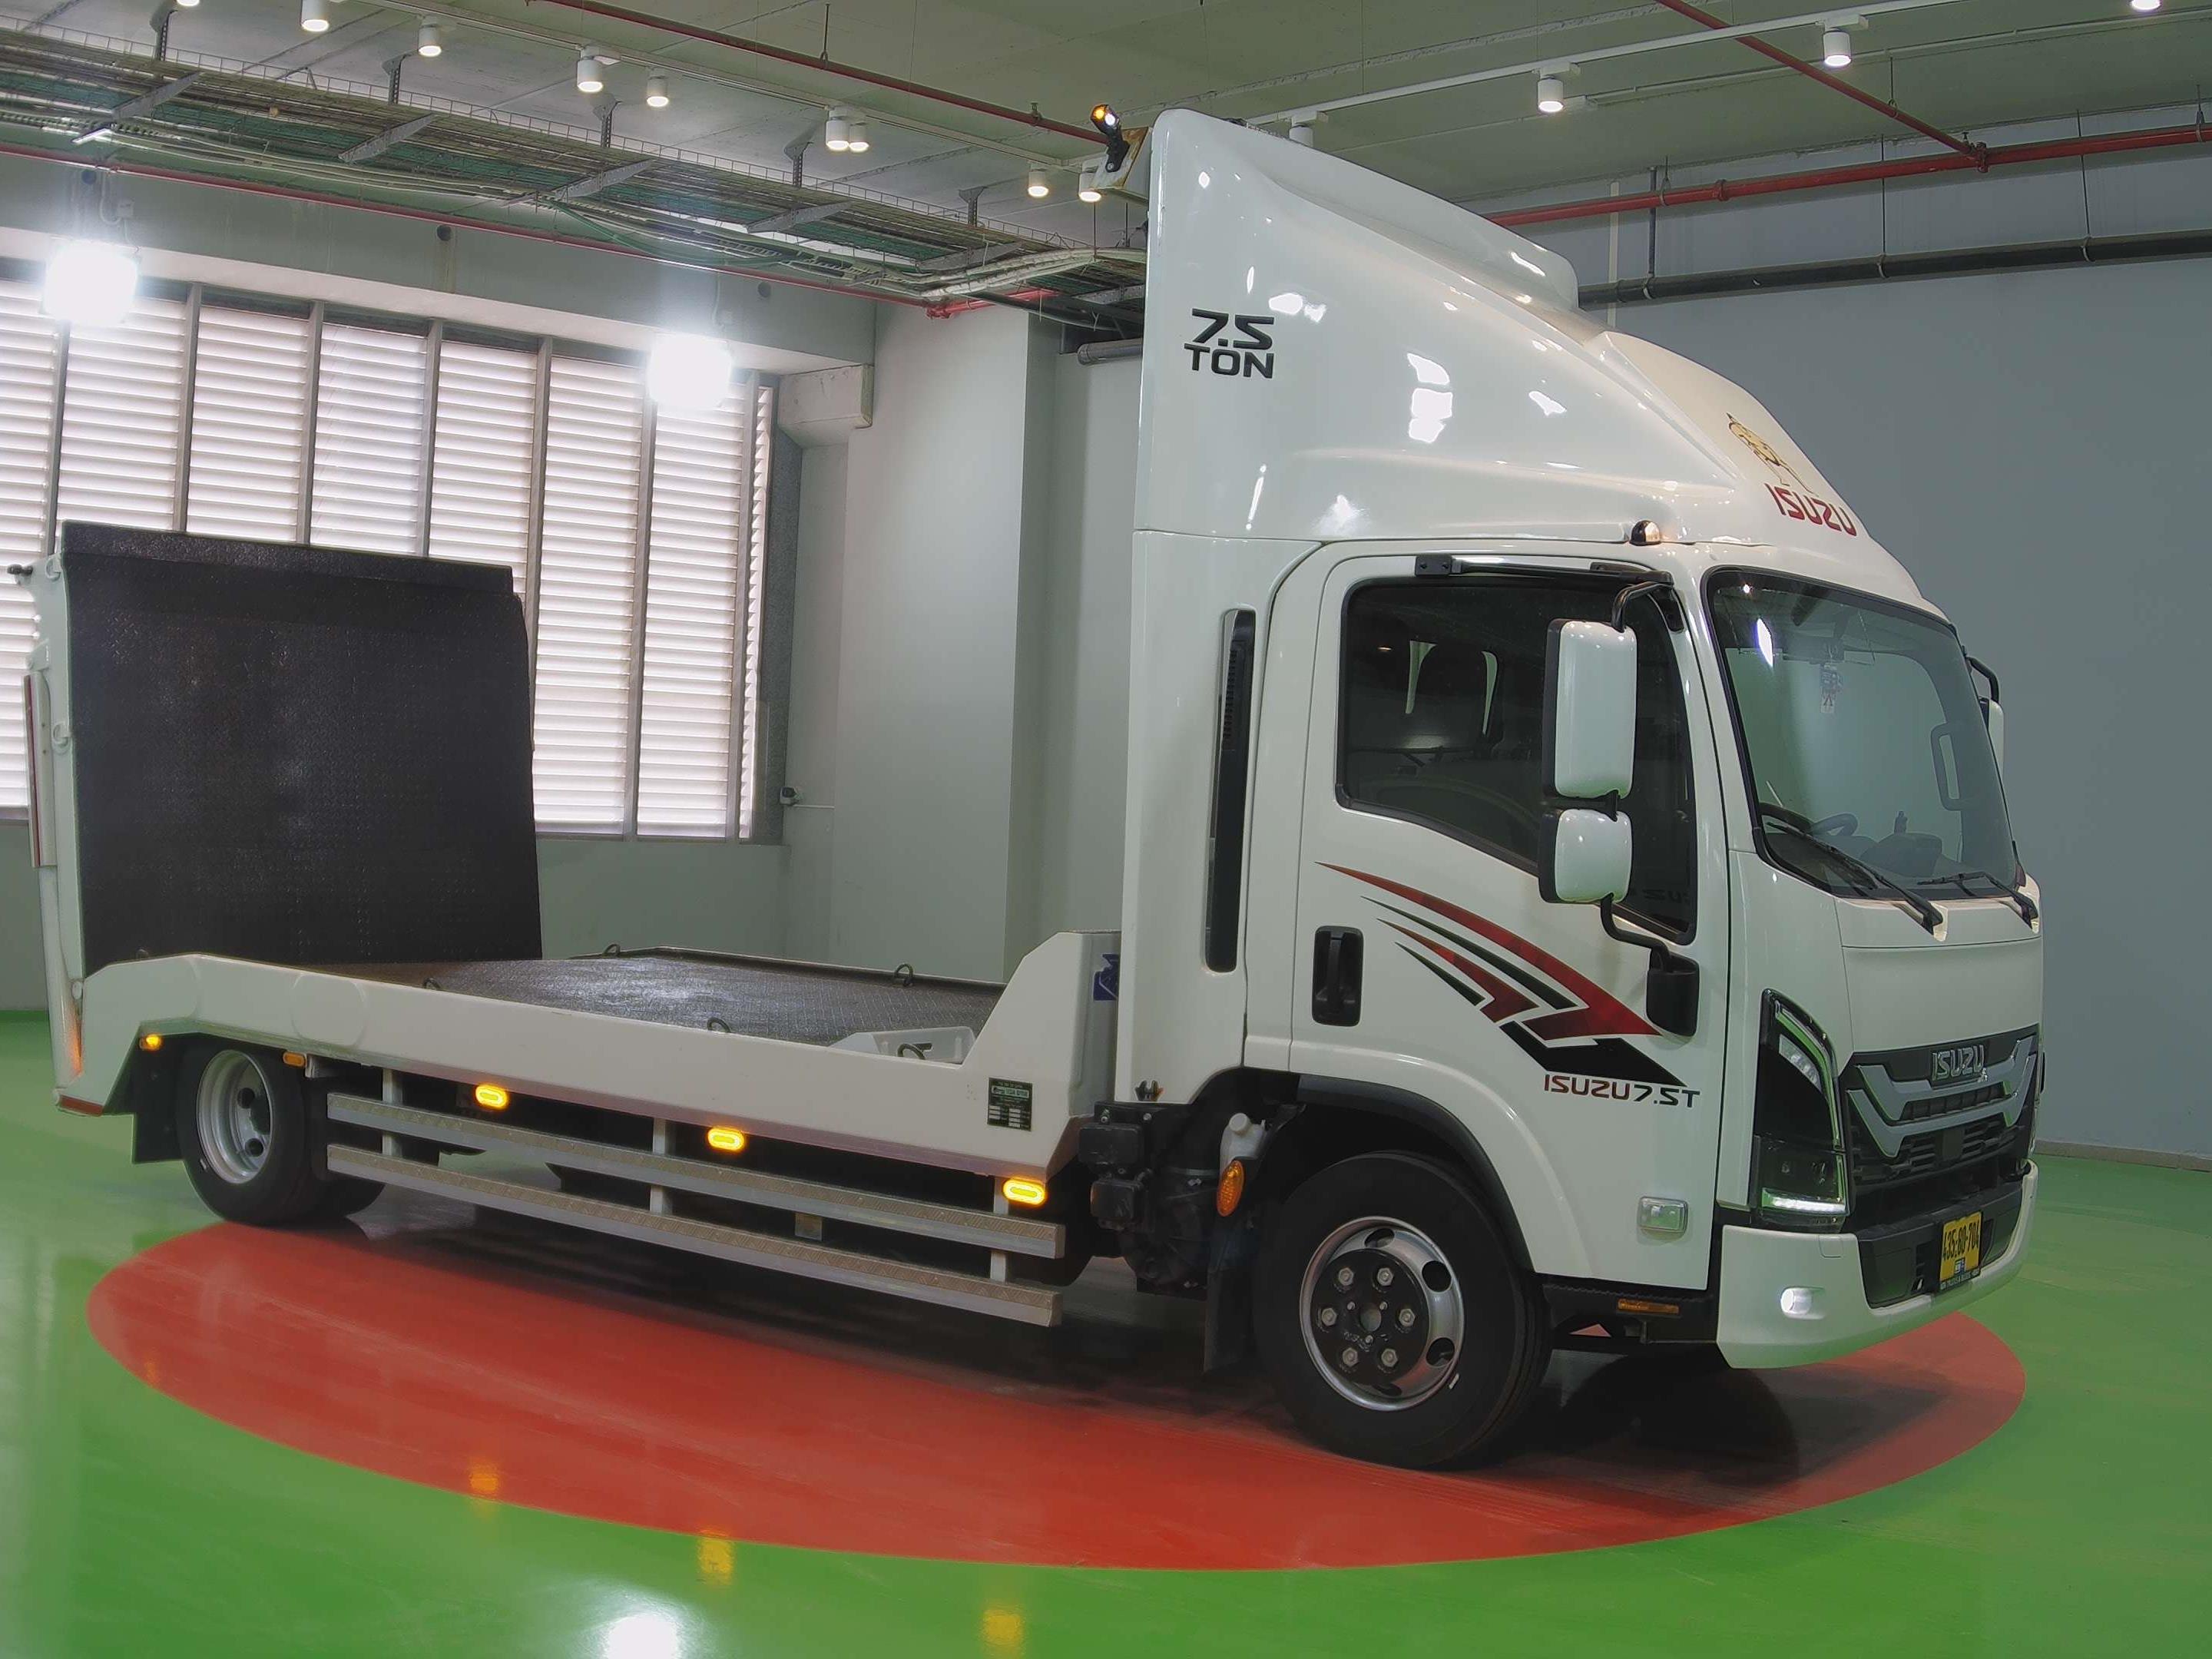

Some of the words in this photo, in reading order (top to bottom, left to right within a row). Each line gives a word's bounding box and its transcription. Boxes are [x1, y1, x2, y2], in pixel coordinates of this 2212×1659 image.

[1192, 308, 1274, 349] 7.5
[1184, 343, 1274, 379] TON
[1765, 483, 1857, 536] ISUZU
[1932, 1045, 1985, 1081] ISUZU
